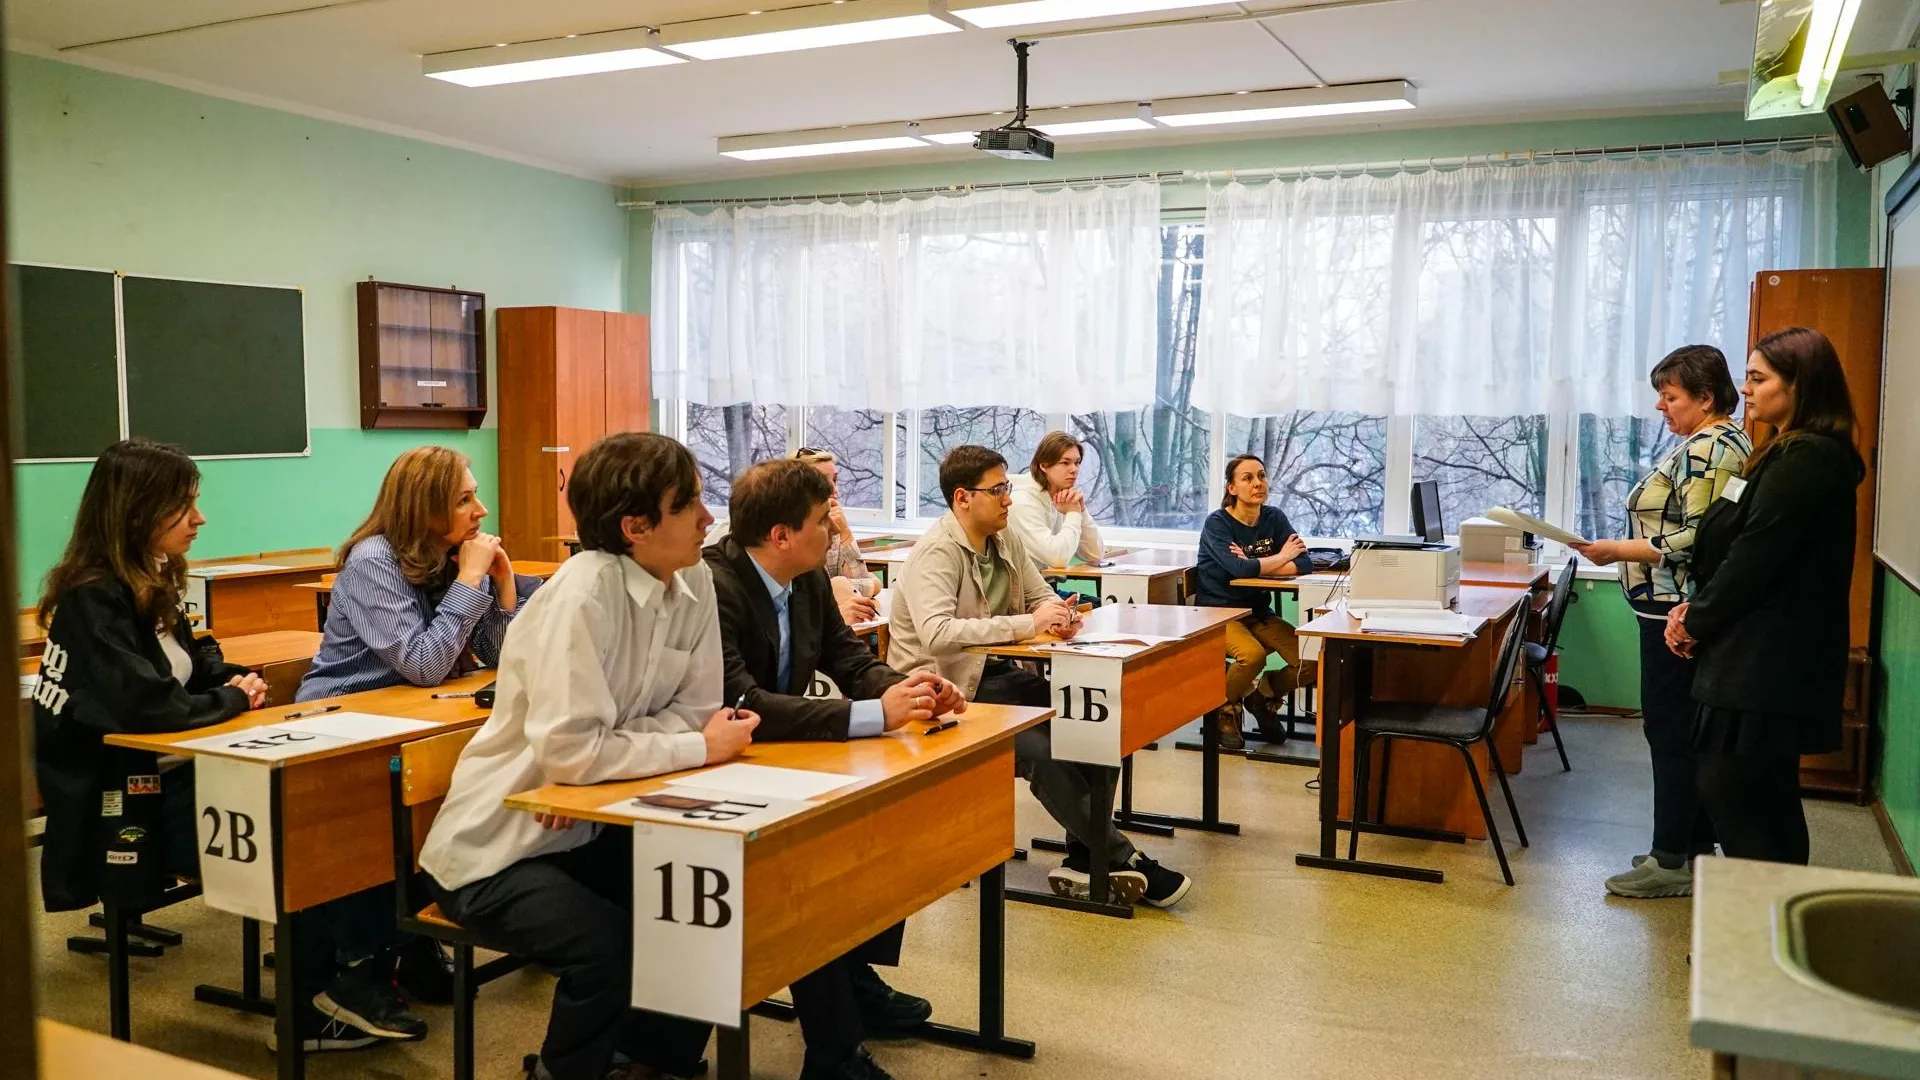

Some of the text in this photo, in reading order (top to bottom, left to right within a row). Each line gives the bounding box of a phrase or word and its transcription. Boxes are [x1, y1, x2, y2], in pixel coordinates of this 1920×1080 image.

[1058, 684, 1109, 723] 1Б
[202, 805, 258, 864] 2В
[653, 861, 732, 929] 1В
